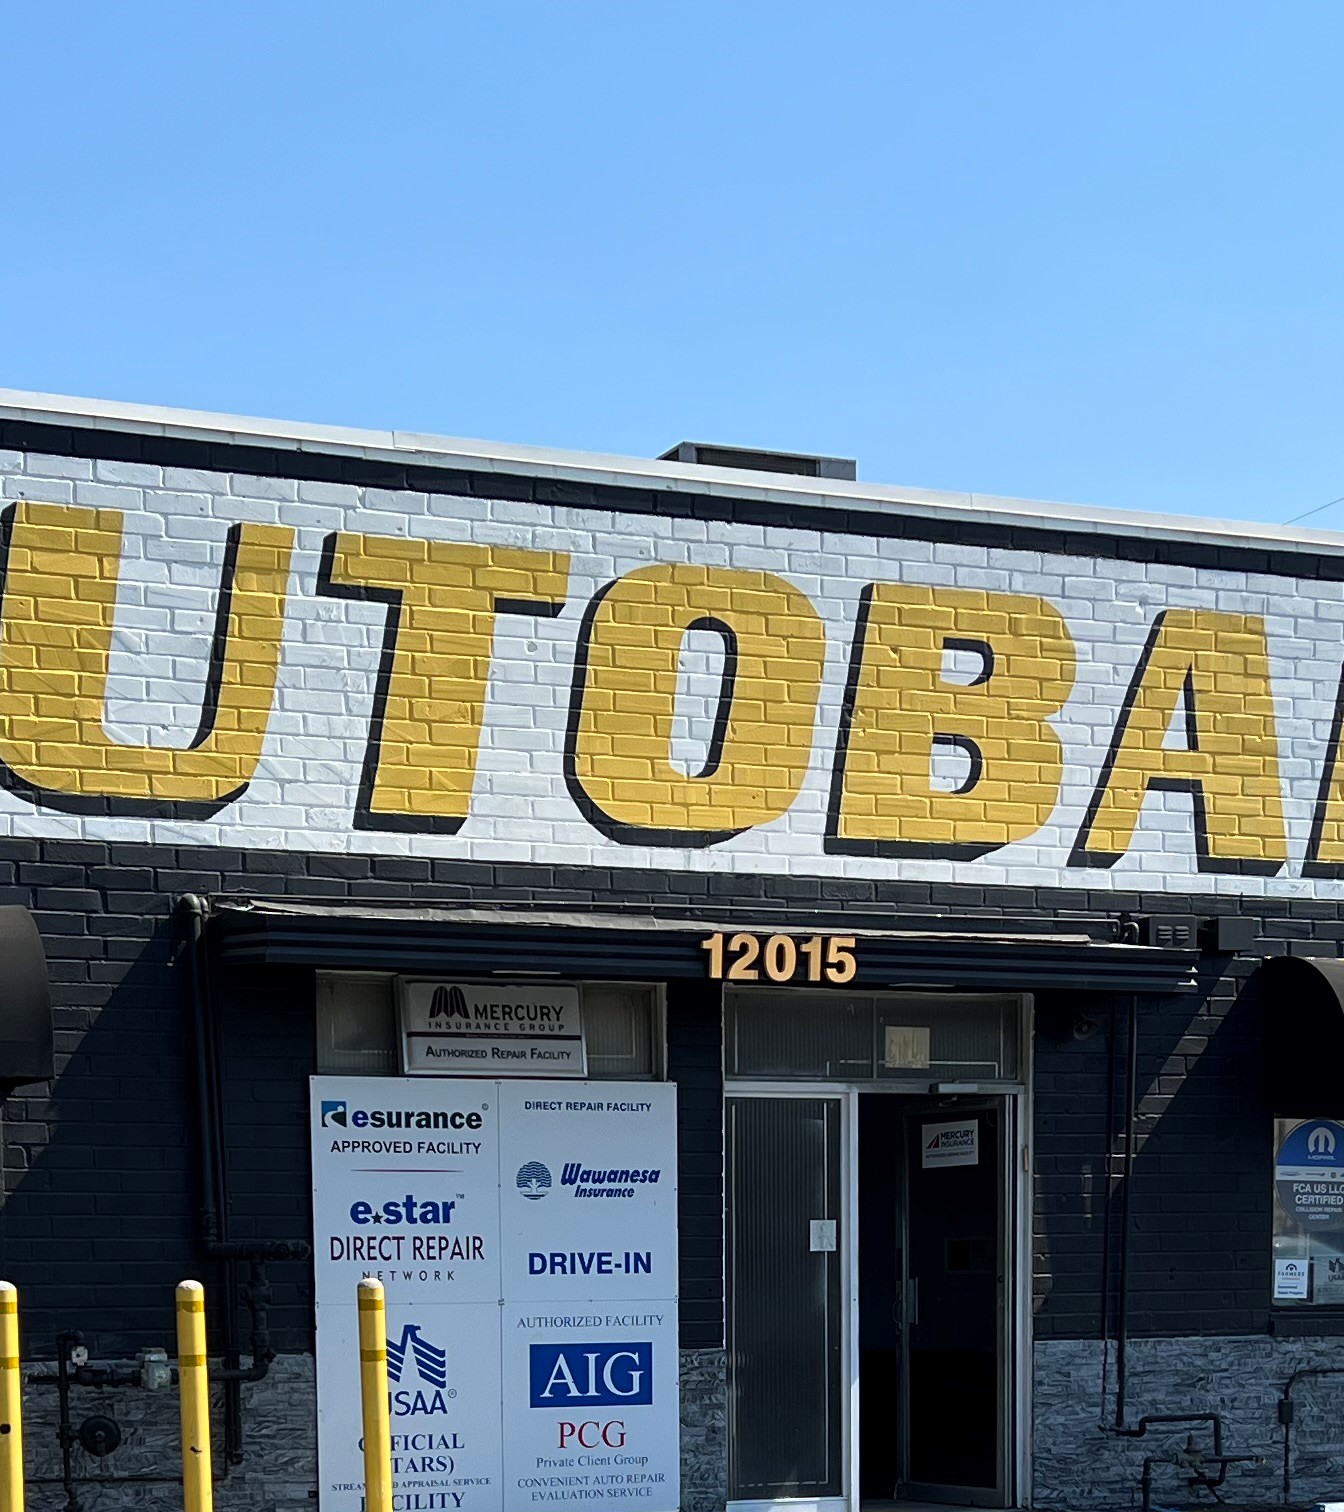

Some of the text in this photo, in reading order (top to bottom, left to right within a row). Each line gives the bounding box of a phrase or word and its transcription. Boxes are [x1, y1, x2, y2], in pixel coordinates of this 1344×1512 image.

[701, 932, 856, 983] 12015
[474, 1003, 564, 1021] MERCURY
[428, 1021, 565, 1032] INSURANCE GROUP
[525, 1101, 652, 1112] DIRECT REPAIR FACILITY
[351, 1110, 482, 1129] esurance
[940, 1129, 974, 1140] MERCURY
[330, 1141, 481, 1154] APPROVED FACILITY
[561, 1163, 661, 1185] Wawanesa
[574, 1185, 635, 1198] Insurance
[1293, 1183, 1311, 1193] FCA
[1314, 1184, 1327, 1193] US
[1295, 1195, 1344, 1205] CERTIFIED
[330, 1236, 485, 1261] DIRECT REPAIR
[528, 1252, 652, 1275] DRIVE-IN
[362, 1270, 455, 1281] NETWORK
[517, 1314, 664, 1328] AUTHORIZED FACILITY
[540, 1352, 644, 1397] AIG
[358, 1433, 465, 1452] FICIAL
[557, 1421, 627, 1449] PCG
[536, 1454, 649, 1469] Private Client Group
[401, 1478, 451, 1489] APPRAISAL
[453, 1477, 492, 1486] SERVICE
[518, 1473, 666, 1488] CONVENIENT AUTO REPAIR
[359, 1491, 466, 1512] CILITY
[531, 1487, 653, 1501] EVALUATION SERVICE
